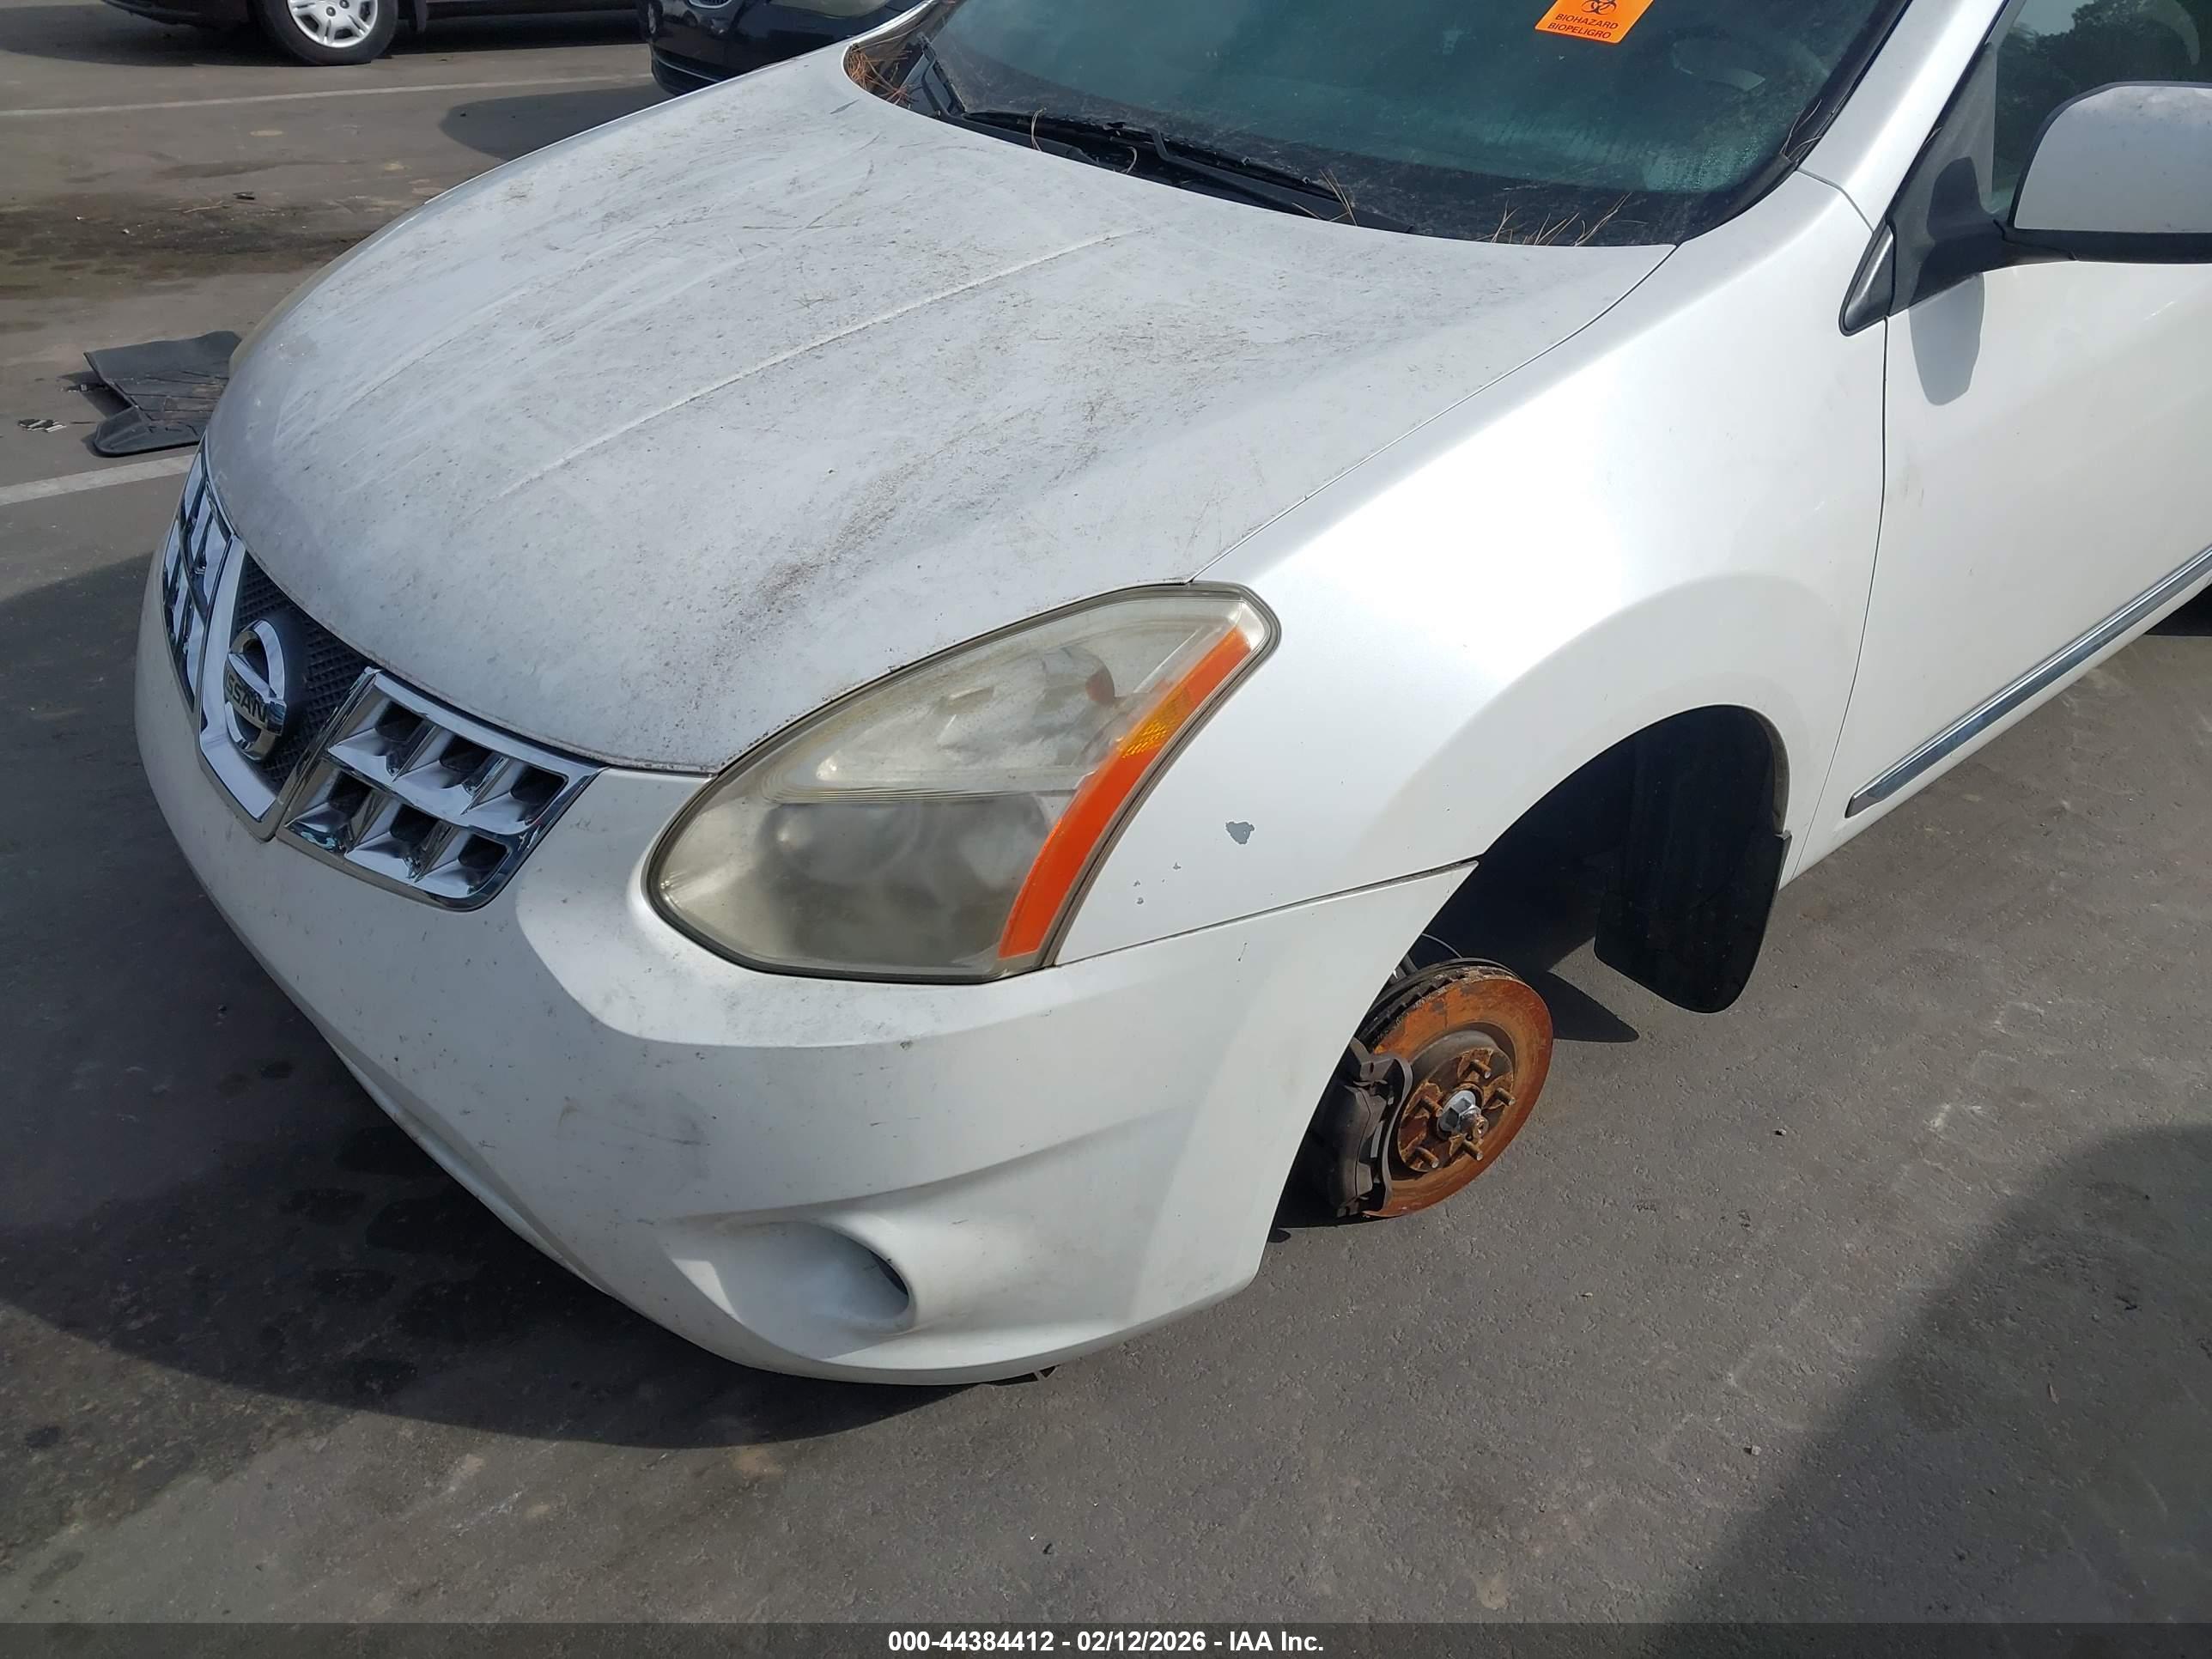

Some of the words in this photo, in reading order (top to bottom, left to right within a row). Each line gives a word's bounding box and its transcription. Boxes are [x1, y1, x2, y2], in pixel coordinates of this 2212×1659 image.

[1555, 13, 1619, 29] BIOHAZARD
[1547, 22, 1612, 39] BIOPELIGRO
[224, 666, 267, 723] ISSAN
